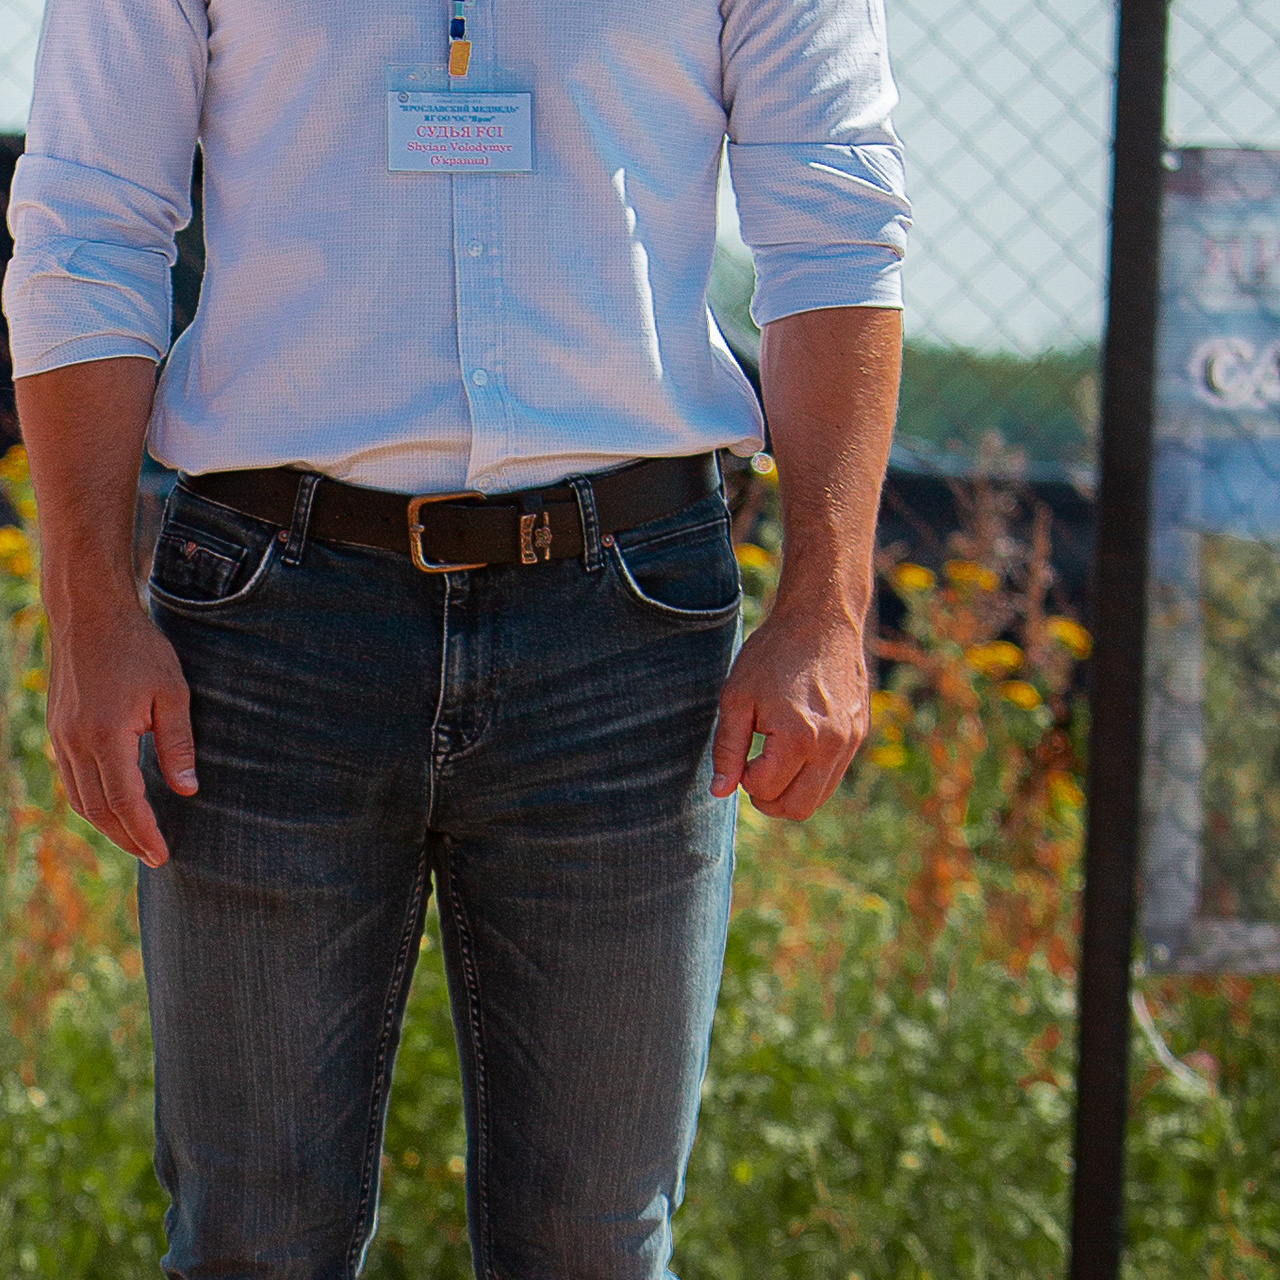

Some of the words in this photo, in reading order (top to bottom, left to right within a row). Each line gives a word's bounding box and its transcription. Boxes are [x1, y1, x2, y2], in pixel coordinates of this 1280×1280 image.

[416, 125, 471, 138] СУДЬЯ
[476, 125, 504, 138] FCI
[407, 142, 447, 153] Shyian
[450, 142, 513, 153] Volodymyr
[430, 155, 490, 166] (Украина)
